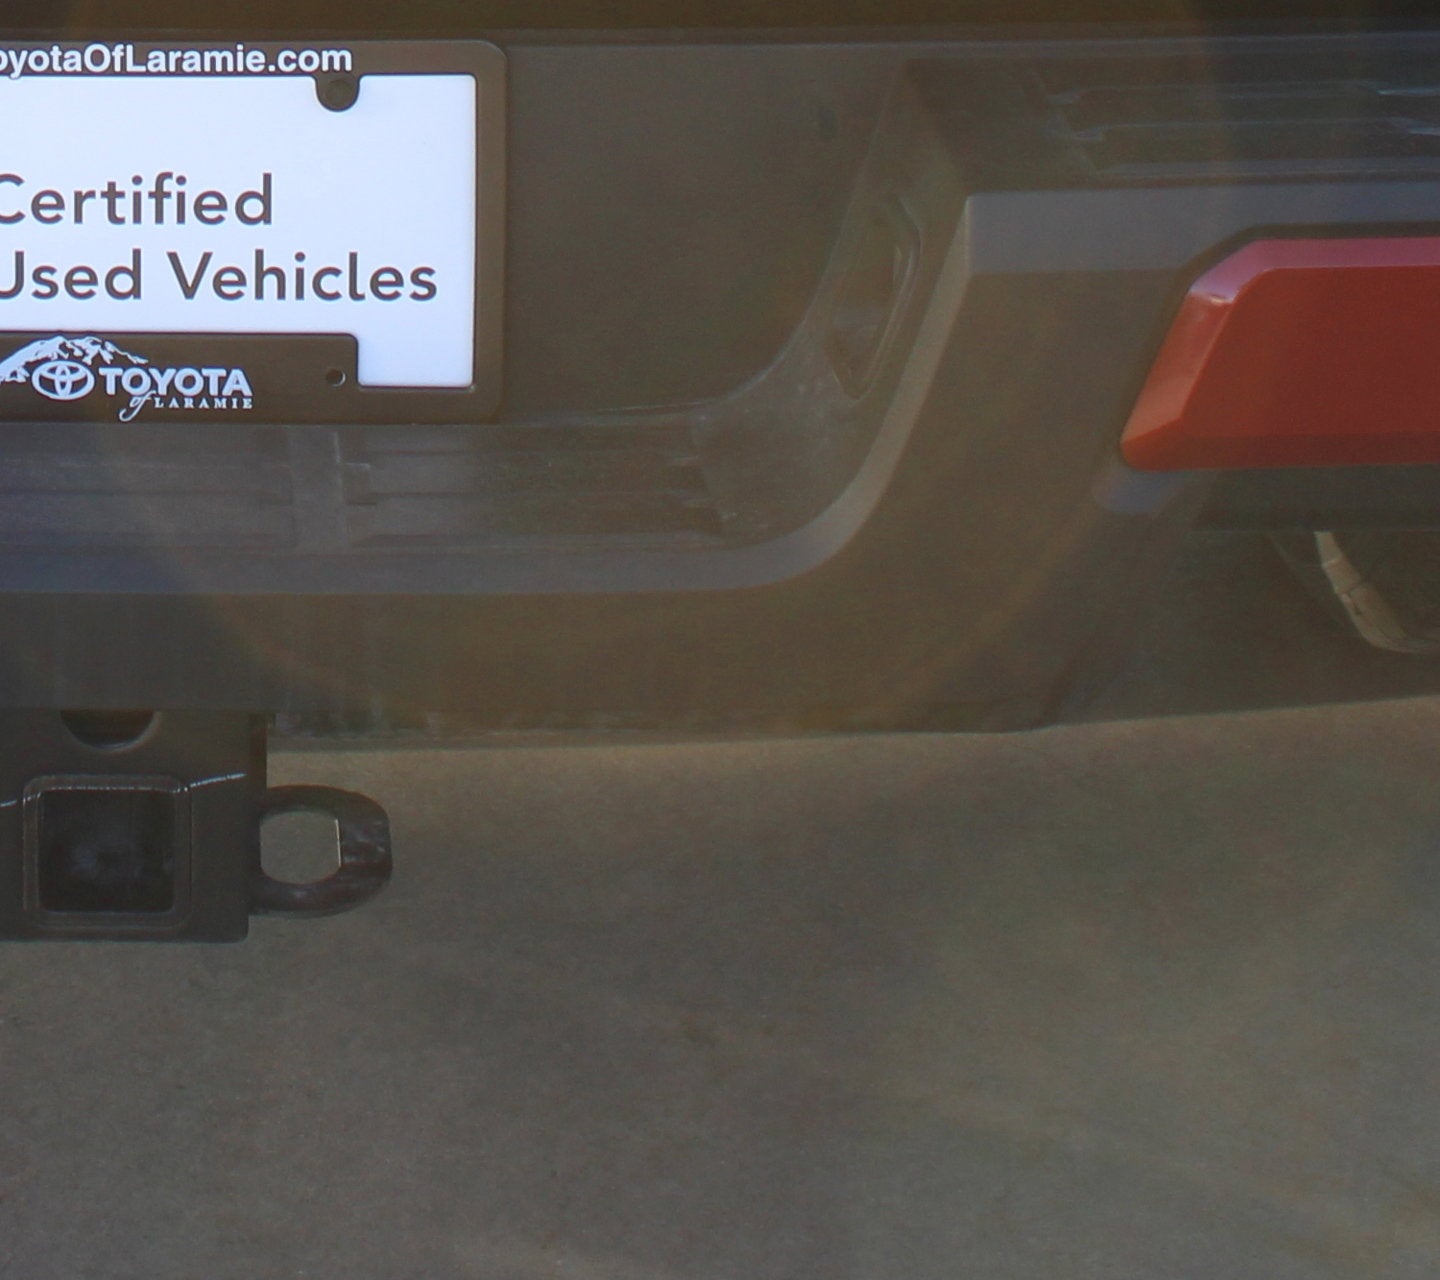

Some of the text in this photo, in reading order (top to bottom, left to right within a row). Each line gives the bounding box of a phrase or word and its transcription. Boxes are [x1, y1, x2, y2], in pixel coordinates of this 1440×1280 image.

[166, 251, 438, 302] Vehicles
[98, 368, 253, 396] TOYOTA
[154, 396, 253, 409] LARAMIE
